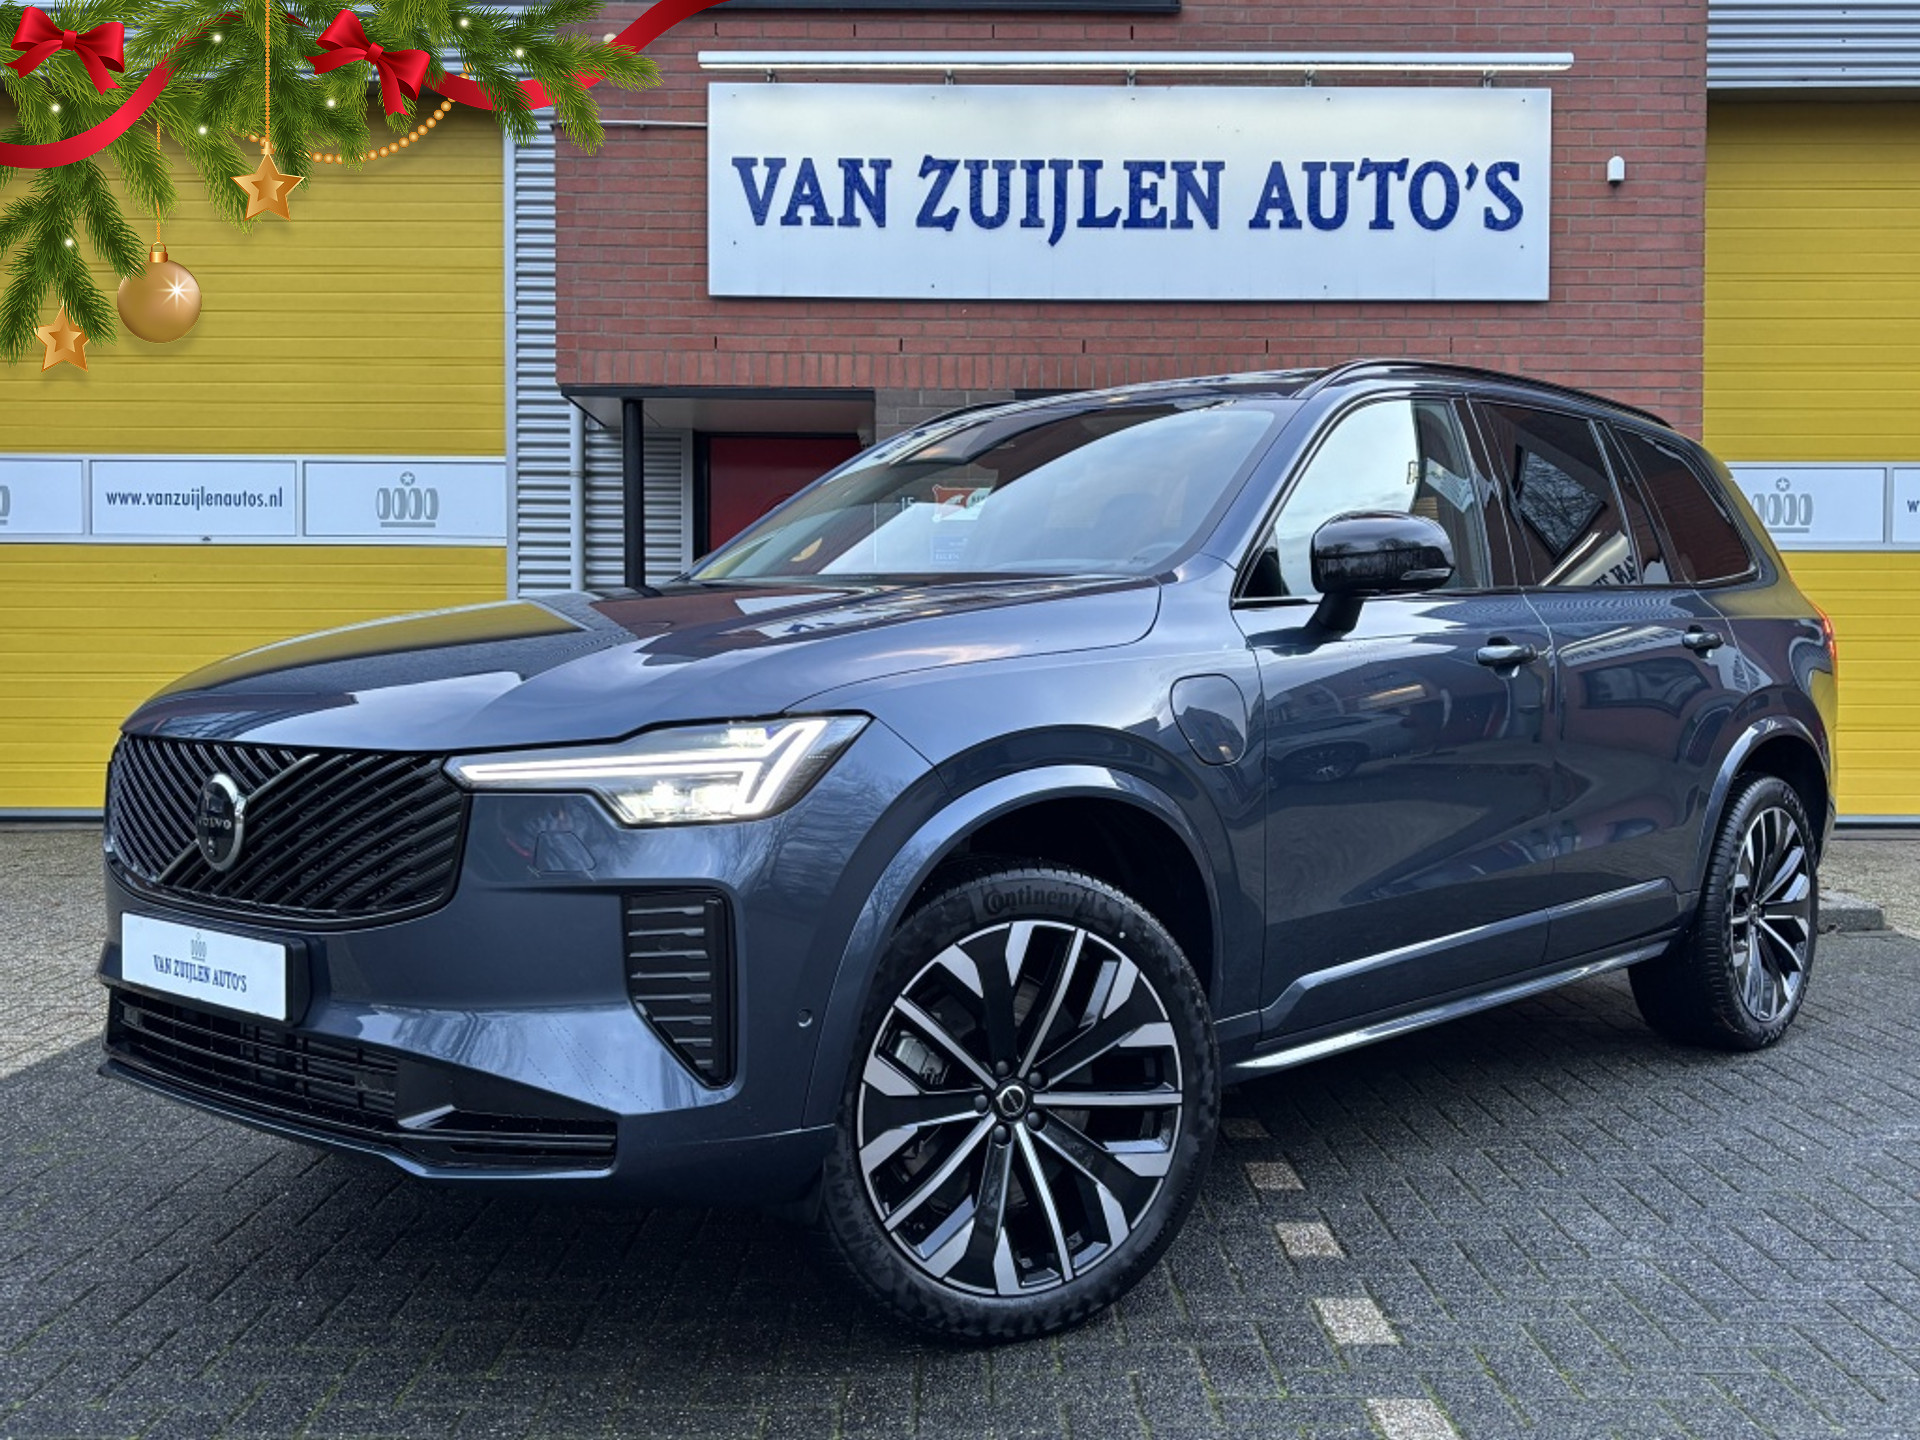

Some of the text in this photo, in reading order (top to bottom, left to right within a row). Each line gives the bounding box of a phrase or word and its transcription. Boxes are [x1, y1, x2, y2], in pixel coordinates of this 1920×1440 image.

[732, 155, 1524, 247] VAN ZUIJLEN AUTO'S
[105, 486, 283, 511] www.vanzuijlenautos.nl
[983, 884, 1097, 915] Continent
[153, 954, 247, 993] VAN ZUIJLEN AUTO'S
